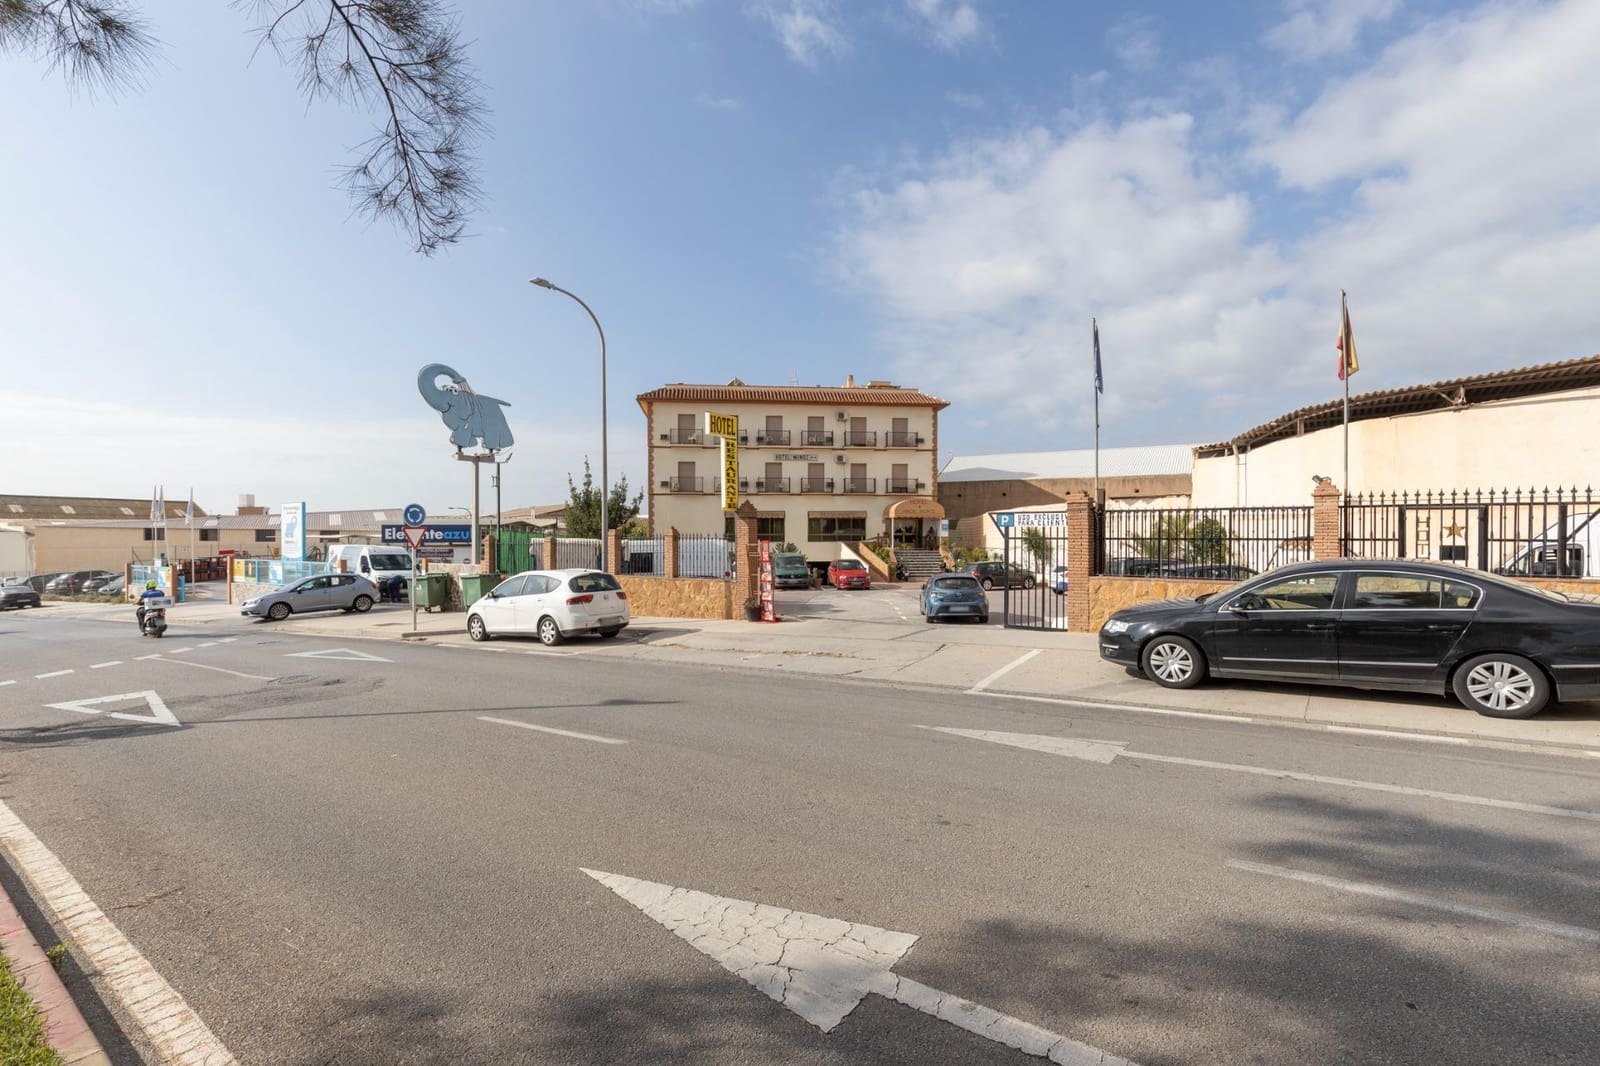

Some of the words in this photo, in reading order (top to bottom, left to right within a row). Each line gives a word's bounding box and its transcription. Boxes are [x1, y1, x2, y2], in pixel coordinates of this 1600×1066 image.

[710, 415, 736, 435] HOTEL
[726, 441, 736, 508] RESTAURANTE
[1001, 515, 1010, 525] P
[1034, 513, 1068, 521] EXCLUSIV
